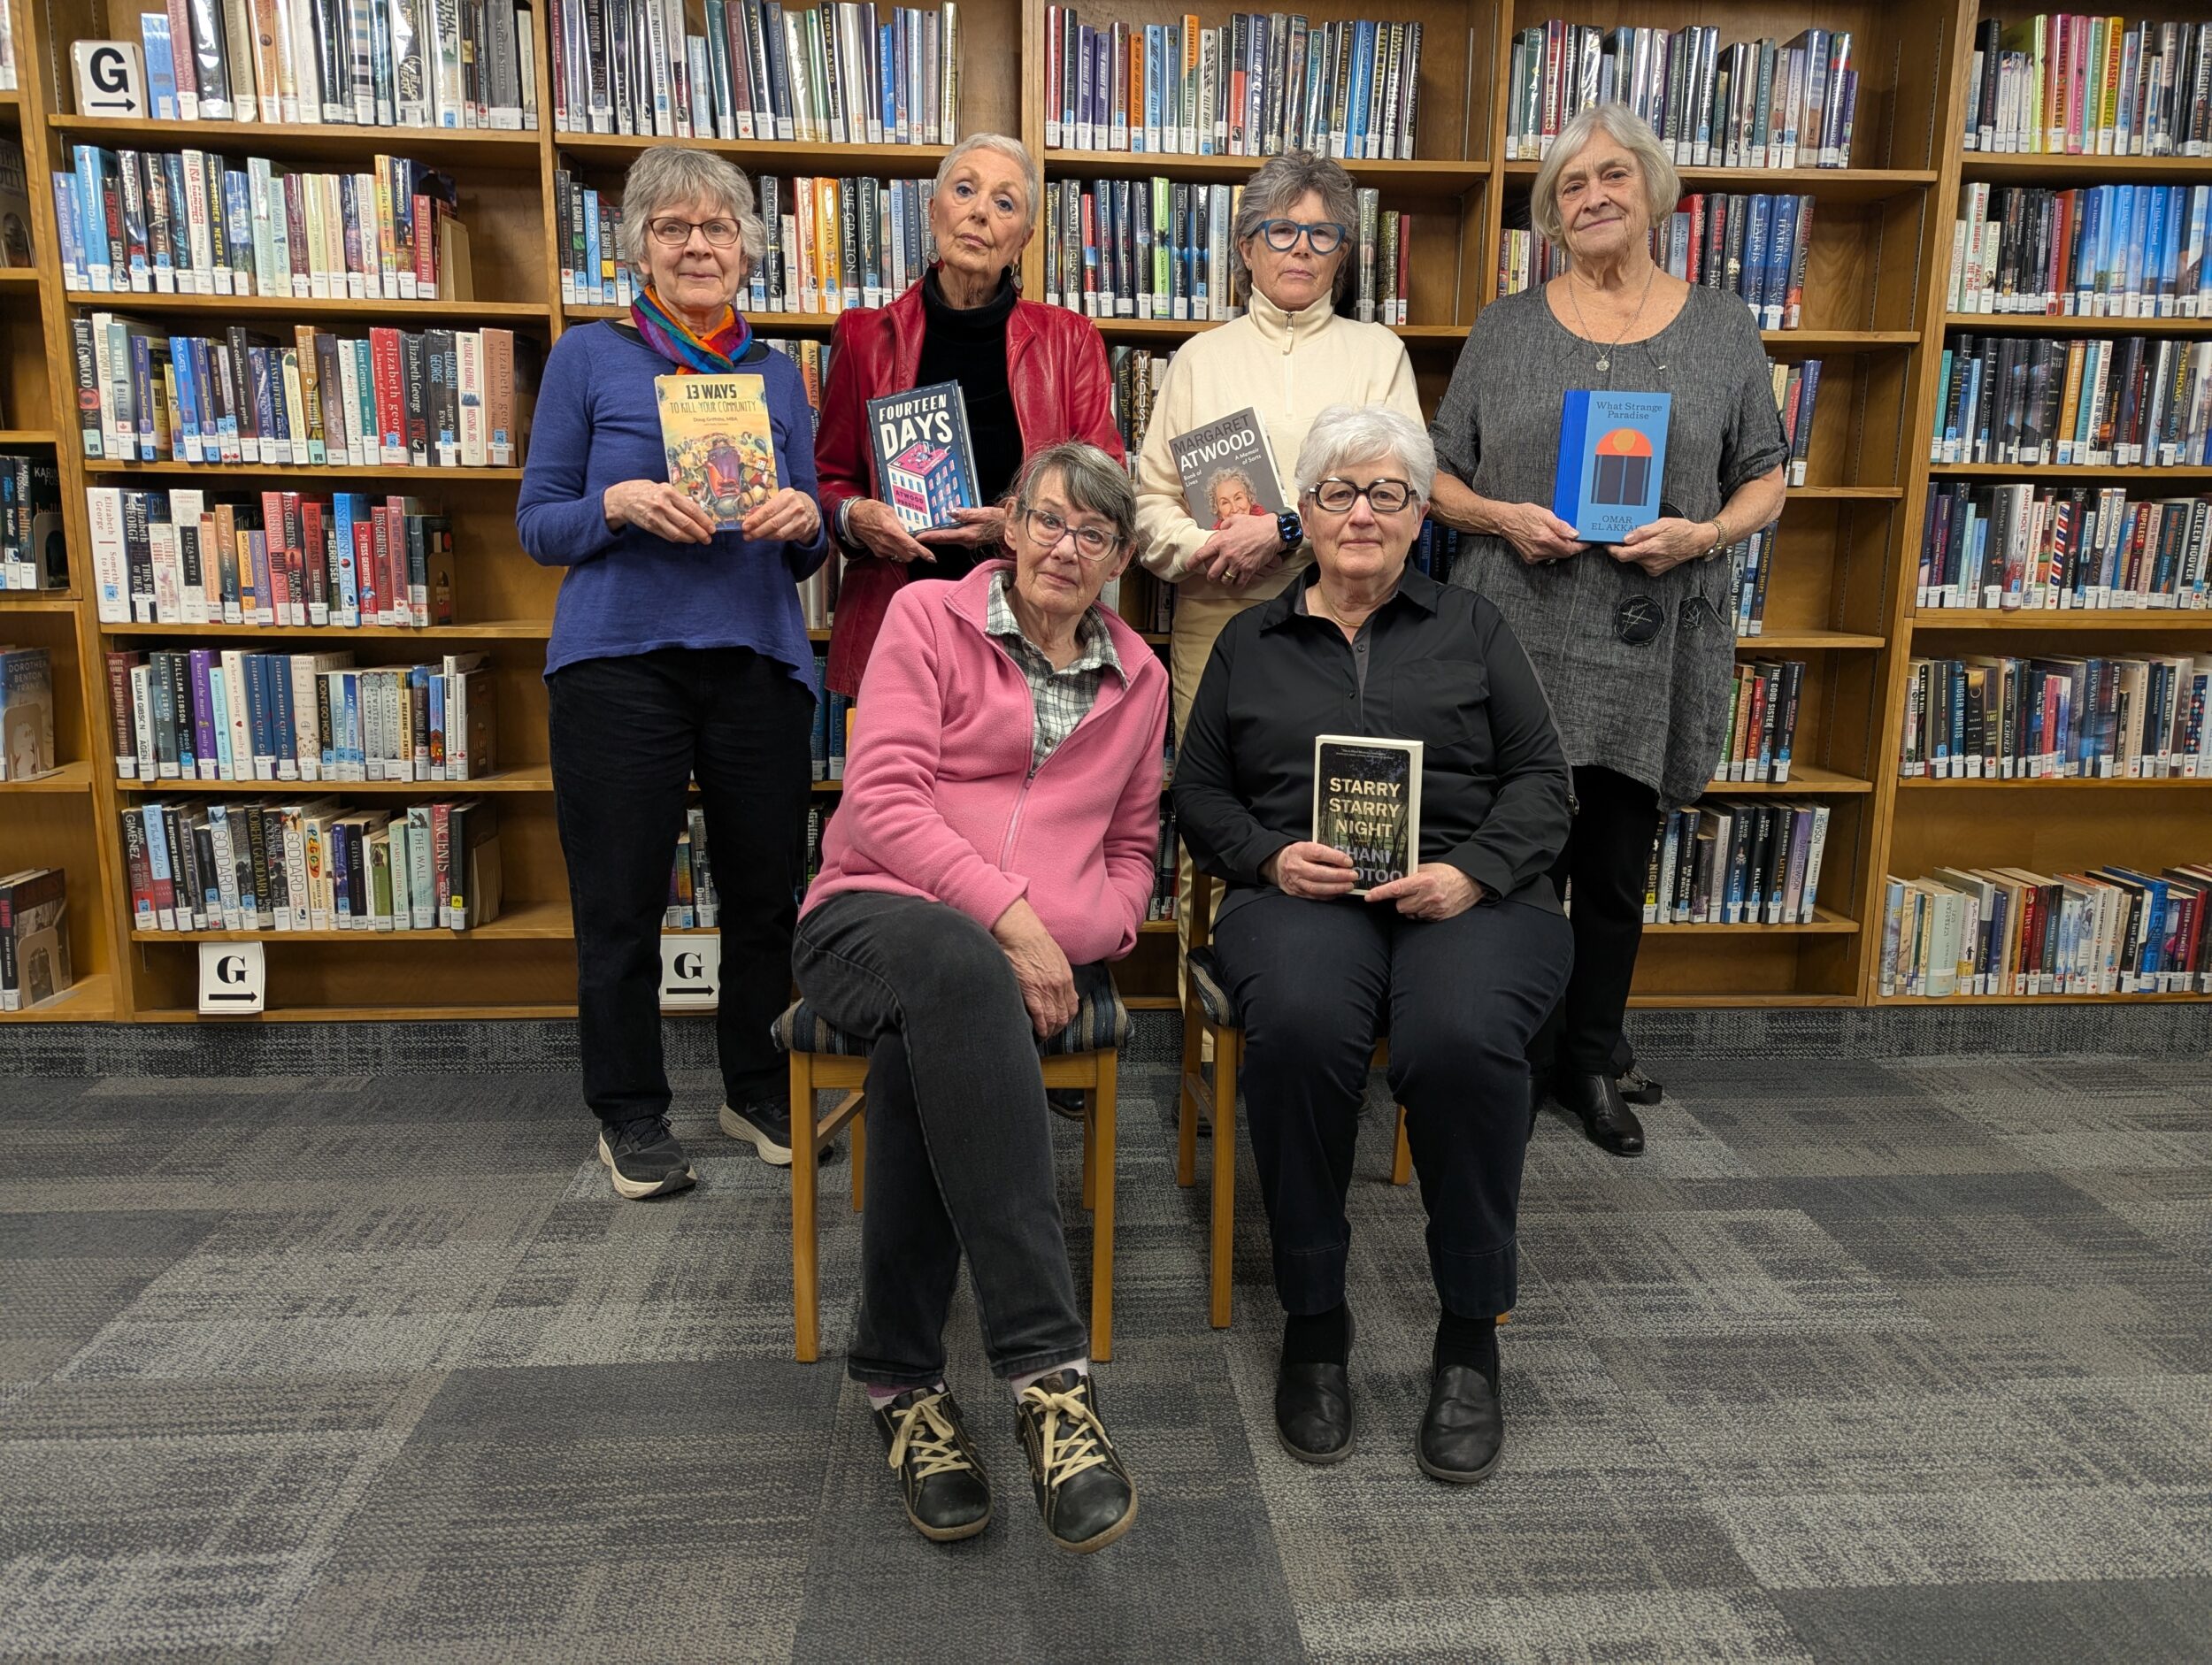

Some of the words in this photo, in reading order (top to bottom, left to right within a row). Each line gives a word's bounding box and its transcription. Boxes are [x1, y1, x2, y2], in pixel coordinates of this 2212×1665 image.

[495, 19, 505, 55] Selected
[652, 20, 662, 48] NIGHT
[824, 8, 832, 45] GHOST
[2112, 24, 2121, 47] CARL
[1378, 28, 1386, 58] GRAVE
[89, 47, 129, 93] G
[655, 52, 665, 95] VISITORS
[1374, 63, 1383, 98] DANGER
[2107, 47, 2119, 88] HIAASEN
[1545, 84, 1556, 130] MERCIES
[2055, 88, 2065, 113] FEVER
[2103, 89, 2116, 127] SQUEEZE
[149, 157, 160, 179] LISA
[1976, 192, 1985, 223] KRISTAN
[601, 222, 611, 231] SUE
[1774, 219, 1787, 263] HARRIS
[1783, 223, 1792, 257] ROBERT
[1972, 225, 1981, 254] HIGGINS
[602, 233, 612, 259] GRAFTON
[1797, 247, 1808, 287] POMPEII
[75, 324, 89, 346] JULIE
[232, 336, 241, 348] the
[234, 350, 245, 384] collective
[357, 343, 366, 362] Lisa
[408, 340, 420, 380] Elizabeth
[2178, 347, 2189, 371] TAMI
[77, 347, 93, 388] GARWOOD
[359, 364, 368, 397] Genova
[387, 340, 401, 398] elizabeth
[430, 354, 443, 384] GEORGE
[445, 351, 457, 389] ELIZABETH
[411, 382, 422, 413] George
[685, 384, 699, 399] 13
[702, 384, 737, 399] WAYS
[2174, 373, 2184, 401] HOAG
[669, 403, 678, 414] TO
[681, 402, 696, 413] KILL
[699, 402, 716, 413] YOUR
[718, 400, 756, 412] COMMUNITY
[879, 394, 947, 422] FOURTEEN
[1596, 401, 1622, 410] What
[1624, 402, 1662, 413] Strange
[1608, 410, 1649, 420] Paradise
[880, 411, 953, 460] DAYS
[1173, 414, 1249, 455] MARGARET
[2169, 417, 2177, 437] BAD
[1180, 429, 1255, 472] ATWOOD
[1240, 447, 1260, 459] Memoir
[1248, 455, 1262, 464] Sorts
[895, 489, 924, 504] ATWOOD
[1186, 479, 1198, 487] Lives
[95, 501, 104, 530] George
[104, 496, 115, 535] Elizabeth
[266, 499, 279, 513] TESS
[308, 508, 317, 522] THE
[375, 513, 384, 525] TESS
[1602, 515, 1632, 524] OMAR
[19, 506, 30, 542] hellfire
[268, 513, 283, 549] GERRITSEN
[309, 524, 317, 539] SPY
[2097, 514, 2107, 545] HOOPER
[2110, 514, 2120, 545] HOOPER
[2137, 508, 2149, 543] HOPELESS
[2191, 503, 2206, 542] COLLEEN
[153, 542, 164, 564] GEORGE
[163, 538, 175, 568] ELIZABETH
[186, 532, 196, 576] ELIZABETH
[309, 540, 319, 564] COAST
[376, 526, 387, 558] GERRITSEN
[1761, 537, 1771, 573] THOUSAND
[2147, 550, 2154, 559] US
[2148, 534, 2156, 549] WITH
[327, 540, 339, 583] GERRITSEN
[2185, 545, 2198, 580] HOOVER
[175, 658, 184, 692] WILLIAM
[1771, 669, 1780, 681] THE
[319, 680, 327, 704] DON'T
[1769, 683, 1778, 702] GOOD
[1956, 676, 1965, 707] TRIGGER
[177, 694, 186, 723] GIBSON
[320, 706, 328, 719] GO
[1765, 704, 1776, 728] SISTER
[322, 720, 330, 743] HOME
[1955, 710, 1964, 738] MORTIS
[1329, 777, 1401, 798] STARRY
[1329, 798, 1401, 818] STARRY
[125, 814, 140, 860] GIMENEZ
[415, 832, 425, 852] THE
[1336, 818, 1393, 838] NIGHT
[168, 826, 177, 854] BUTCHER'S
[173, 856, 181, 881] DAUGHTER
[307, 829, 319, 872] PEGGY
[436, 814, 449, 872] ANCIENTS
[213, 830, 234, 892] GODDARD
[286, 832, 304, 892] GODDARD
[417, 855, 426, 881] WALL
[1352, 867, 1403, 883] OTOO
[1777, 859, 1785, 883] LITTLE
[1648, 863, 1659, 893] NIGHT
[2131, 923, 2140, 935] last
[2128, 937, 2138, 957] affair
[217, 955, 250, 984] G
[674, 952, 705, 979] G
